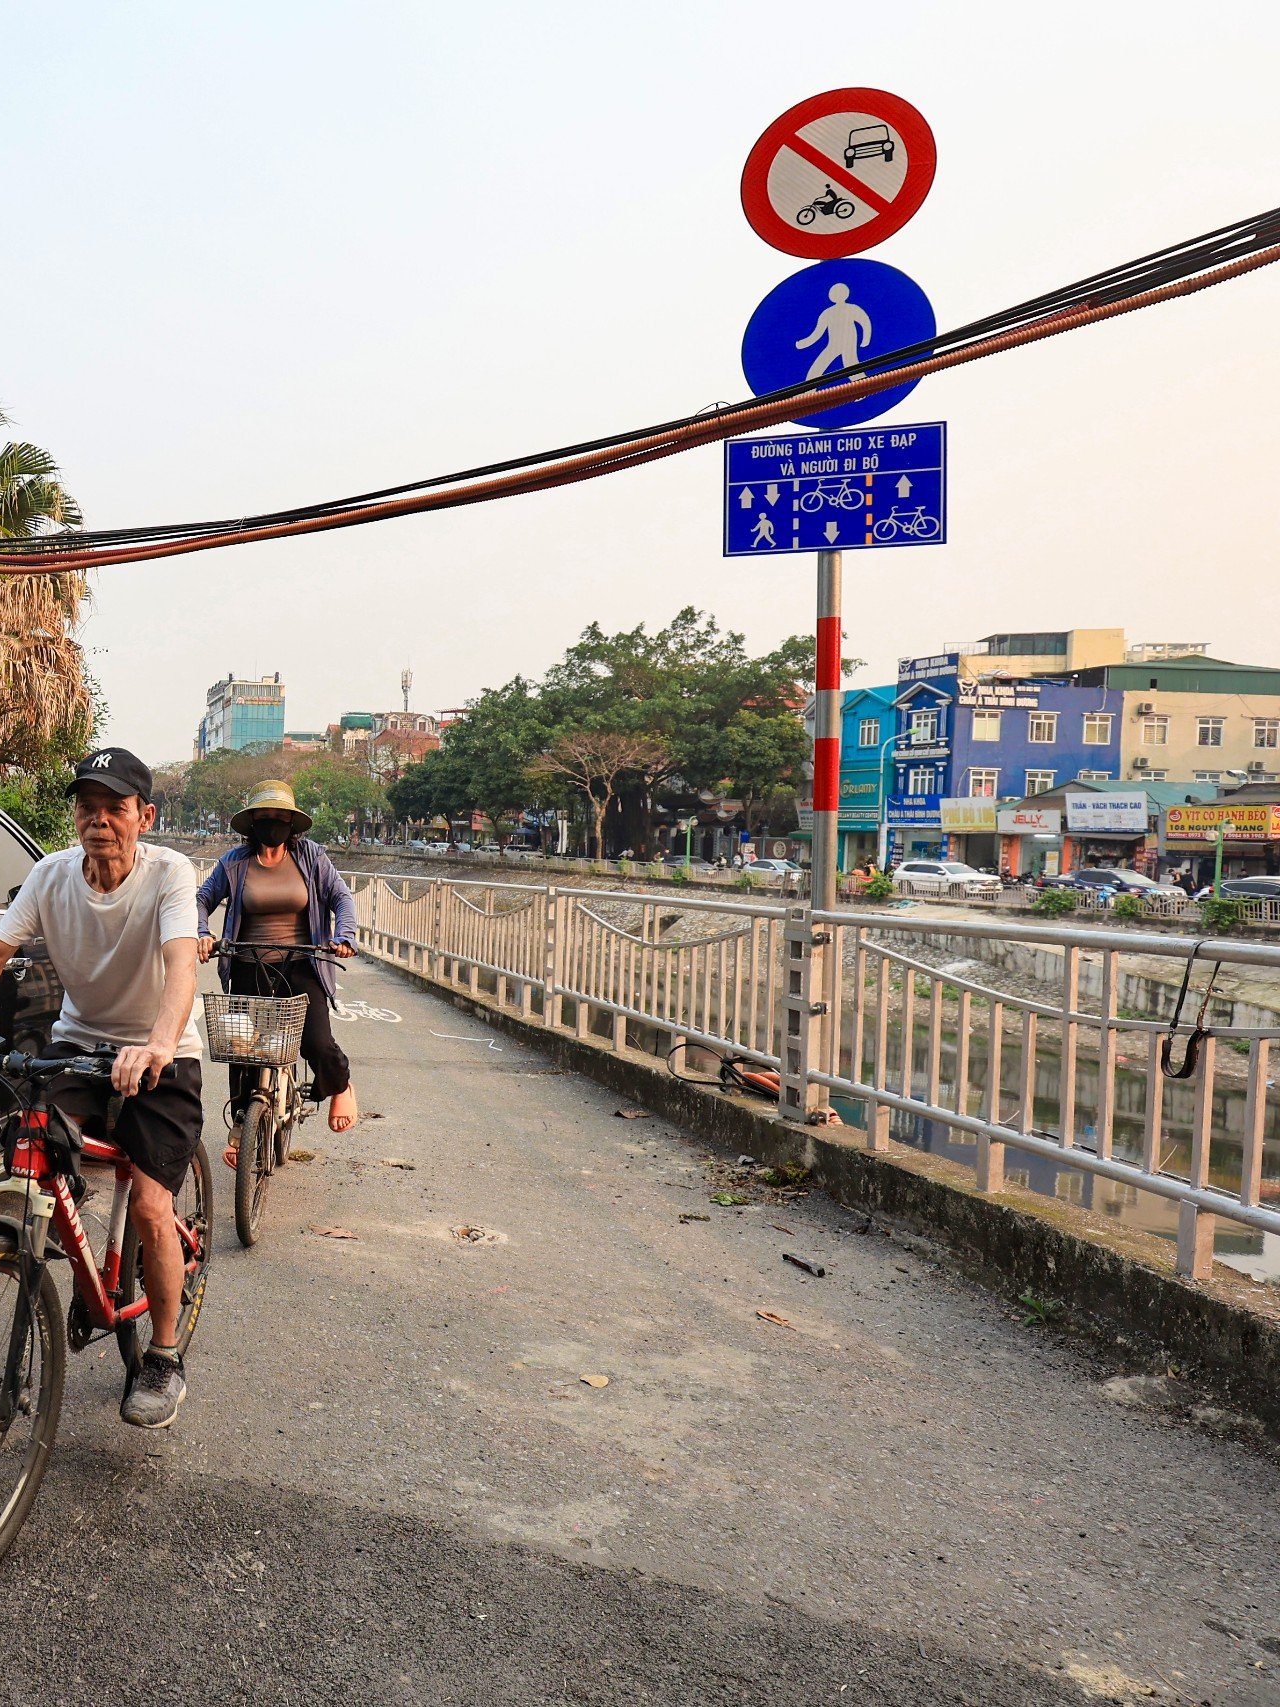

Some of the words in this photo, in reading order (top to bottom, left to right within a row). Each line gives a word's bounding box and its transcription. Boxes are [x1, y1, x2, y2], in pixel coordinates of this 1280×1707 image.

[751, 441, 793, 459] ĐƯỜNG
[798, 437, 832, 455] DÀNH
[837, 437, 862, 452] CHO
[868, 435, 885, 450] XE
[890, 432, 917, 450] ĐẠP
[780, 459, 796, 476] VÀ
[801, 455, 838, 475] NGƯỜI
[843, 457, 856, 472] ĐI
[862, 453, 879, 472] BỘ
[91, 753, 113, 768] NY
[1012, 814, 1043, 825] JELLY
